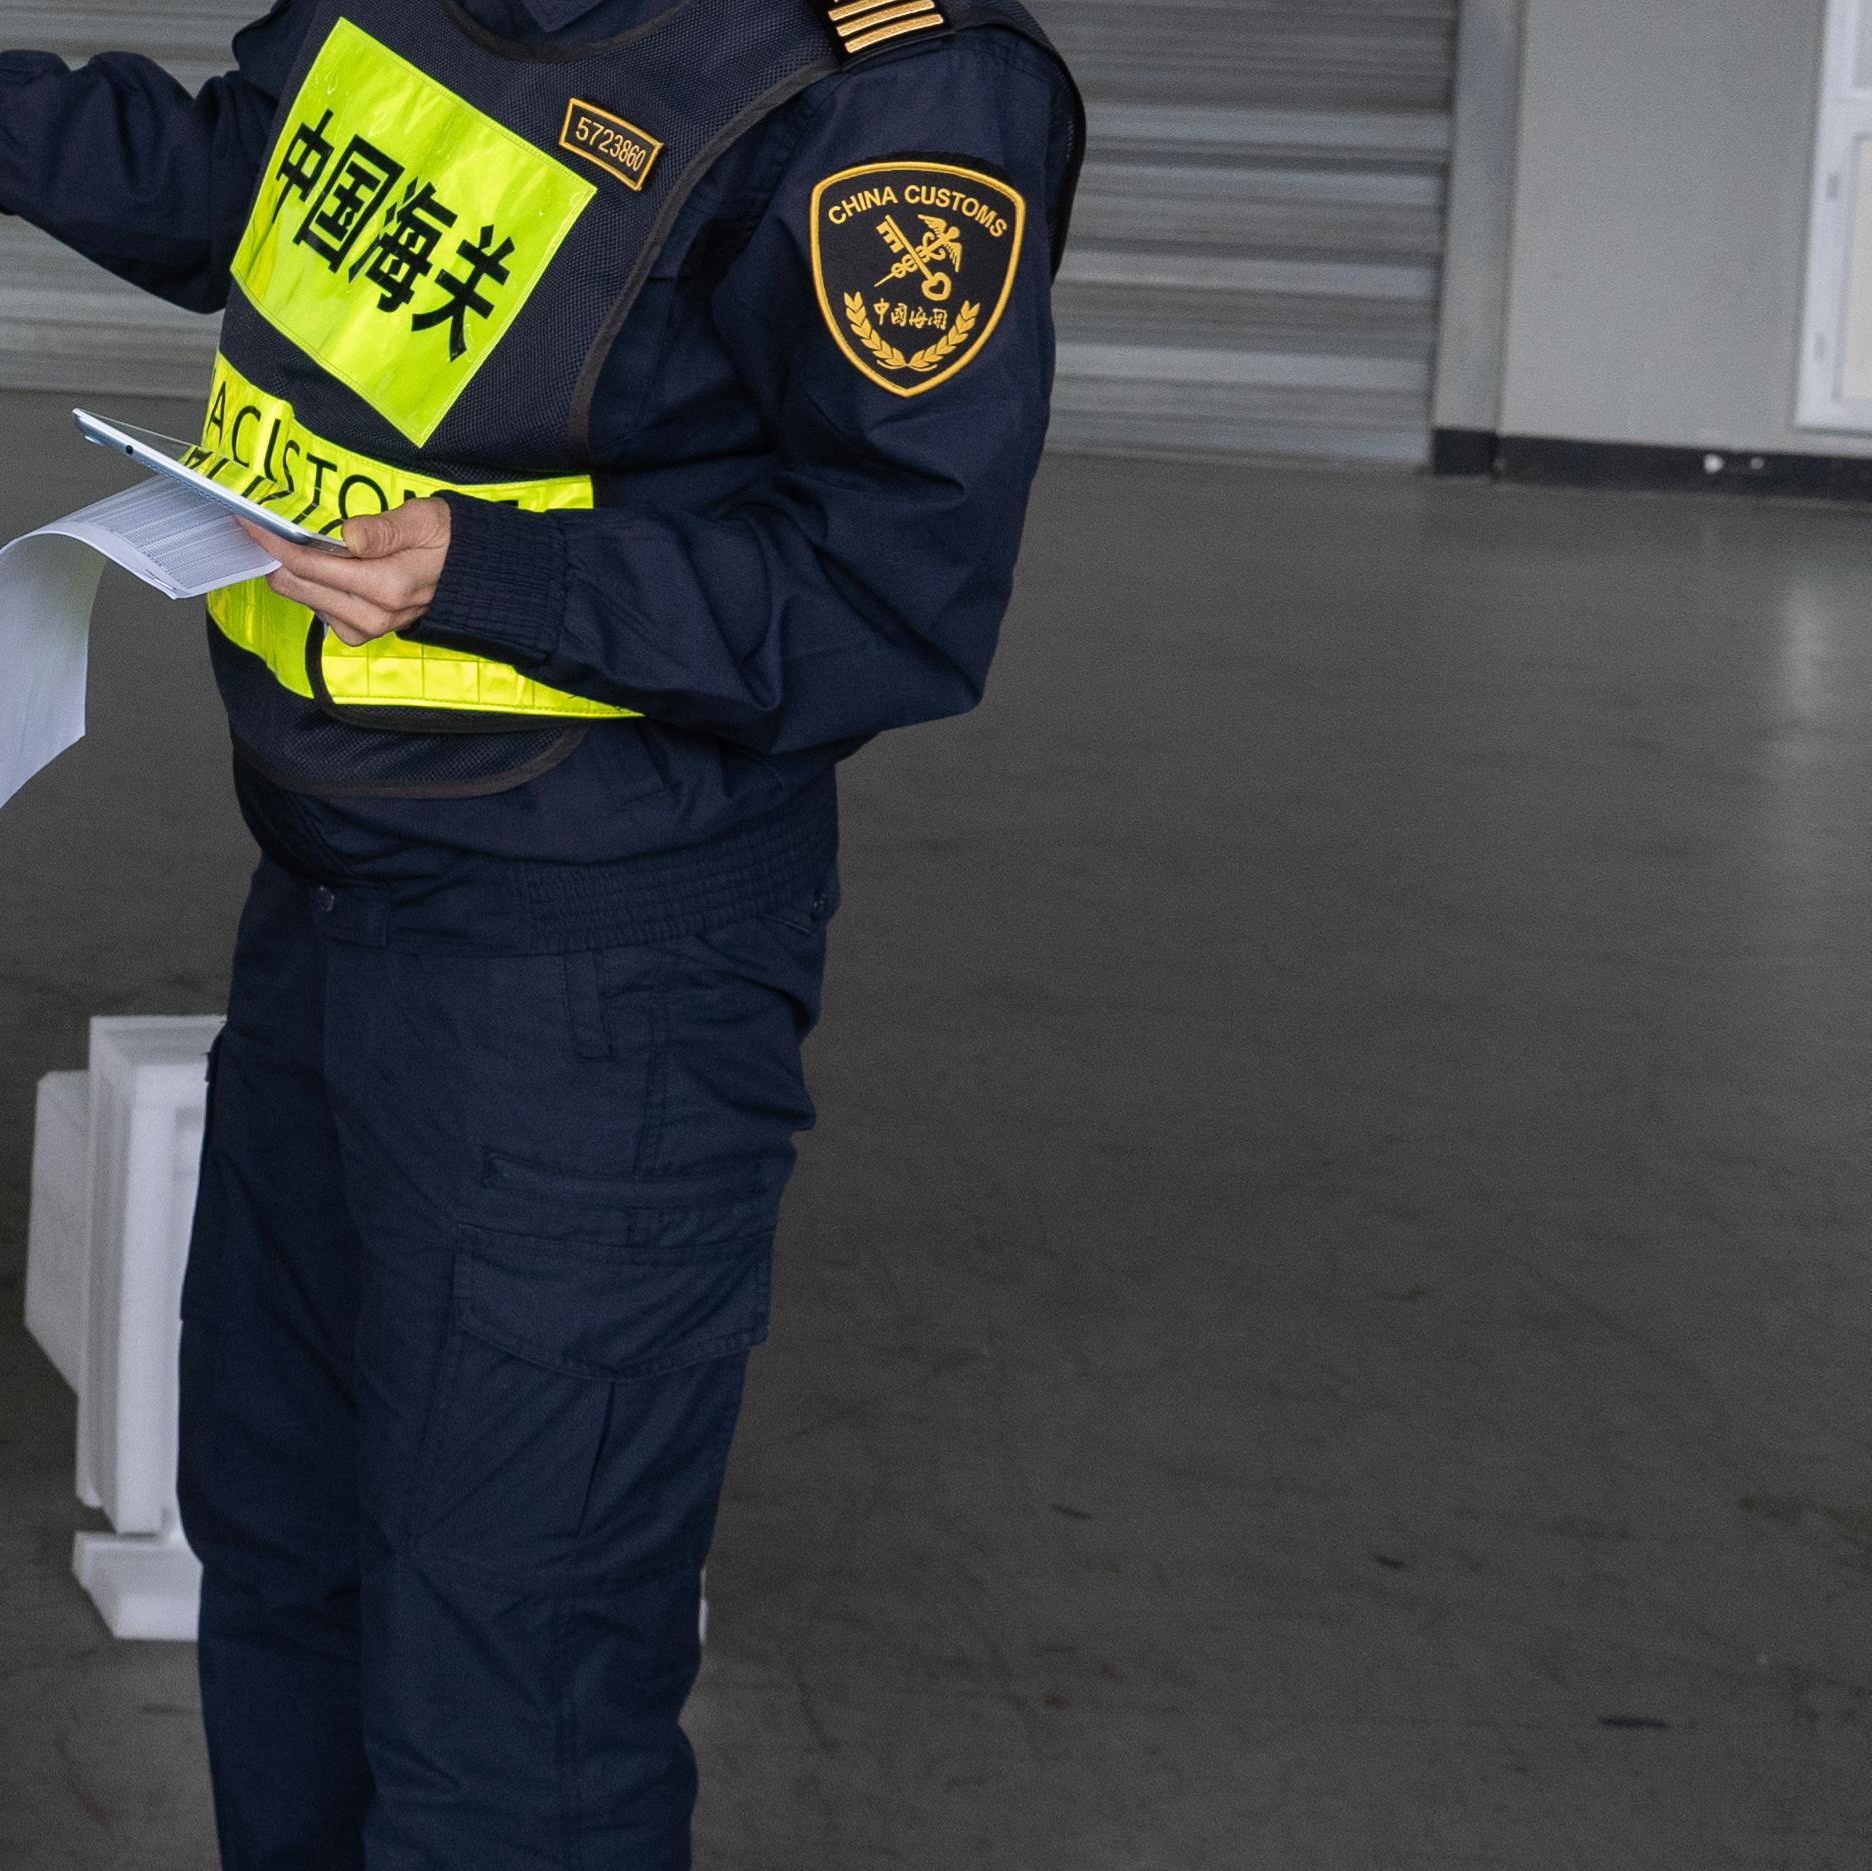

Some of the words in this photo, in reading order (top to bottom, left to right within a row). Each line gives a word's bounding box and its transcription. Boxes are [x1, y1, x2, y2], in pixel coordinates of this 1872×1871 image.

[576, 116, 647, 171] 5723860
[245, 108, 515, 362] 中国海关
[828, 185, 899, 225] CHINA
[904, 184, 1008, 238] CUSTOMS
